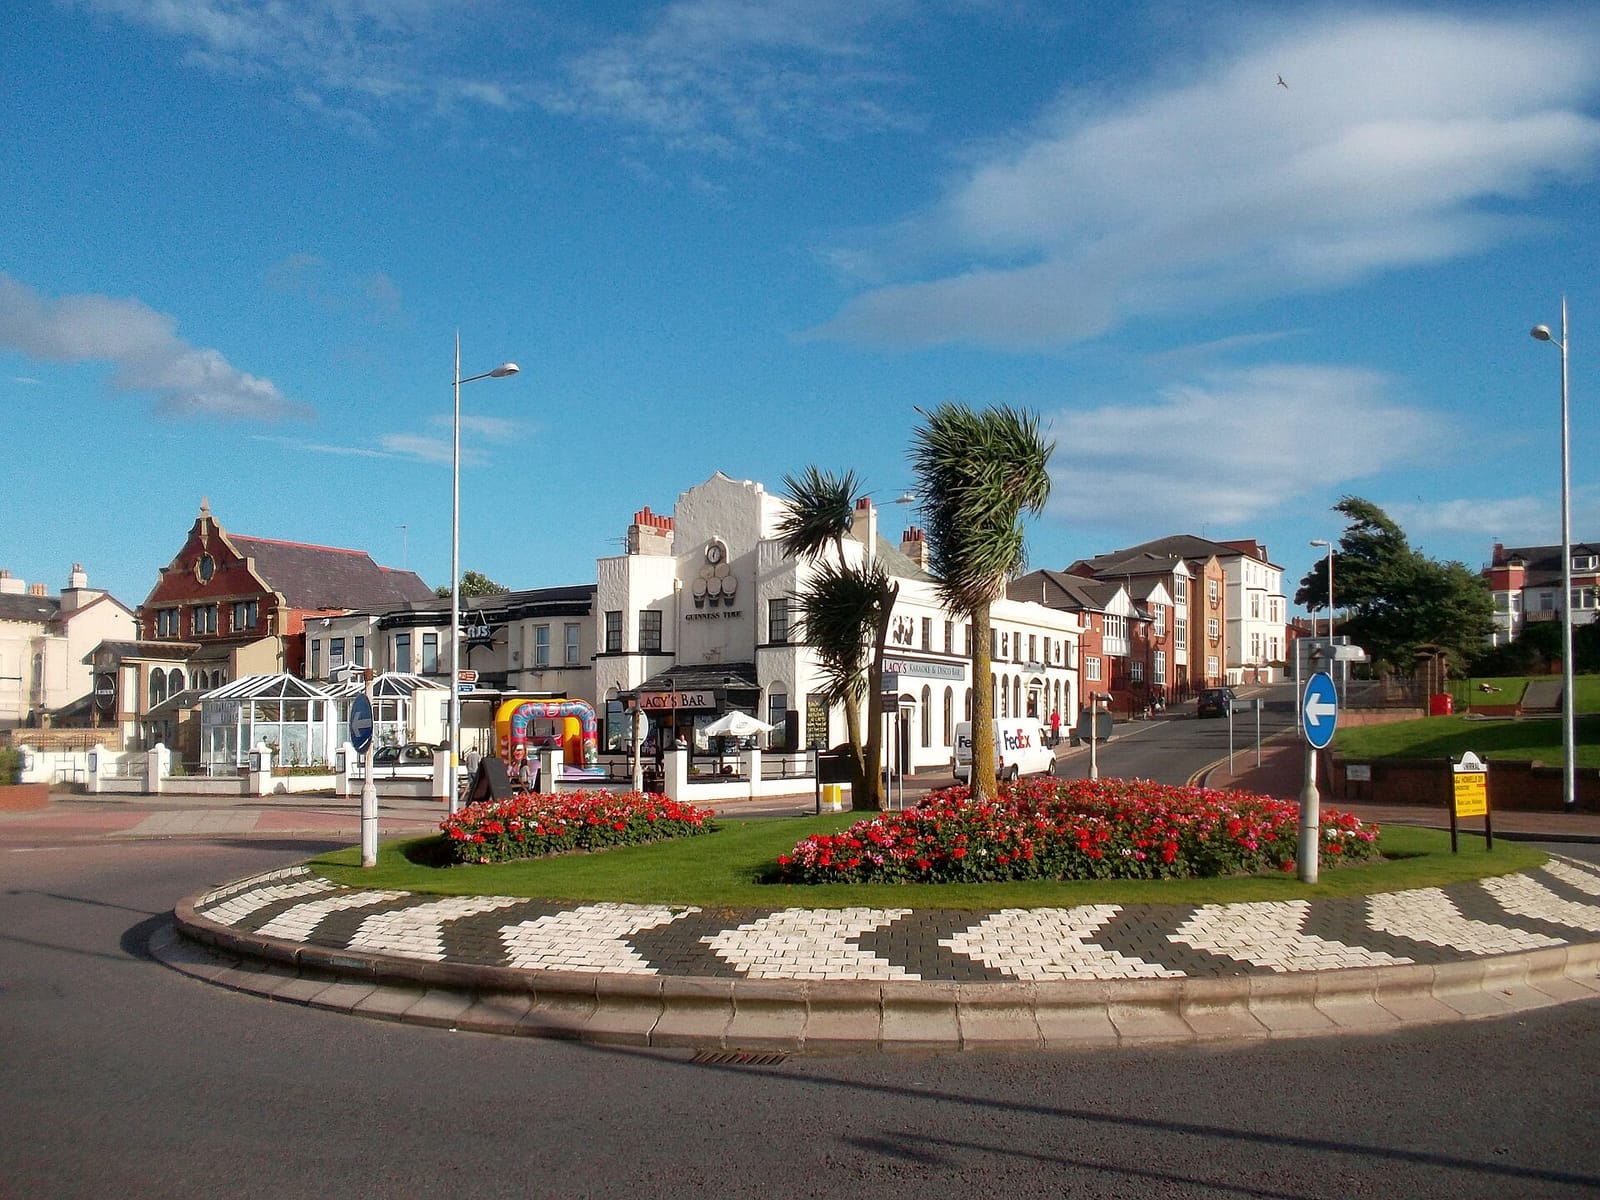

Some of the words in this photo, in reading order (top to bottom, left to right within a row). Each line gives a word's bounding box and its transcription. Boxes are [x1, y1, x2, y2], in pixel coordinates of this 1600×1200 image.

[884, 660, 907, 673] LACY'S
[681, 693, 706, 707] BAR
[1003, 728, 1031, 751] FedEx
